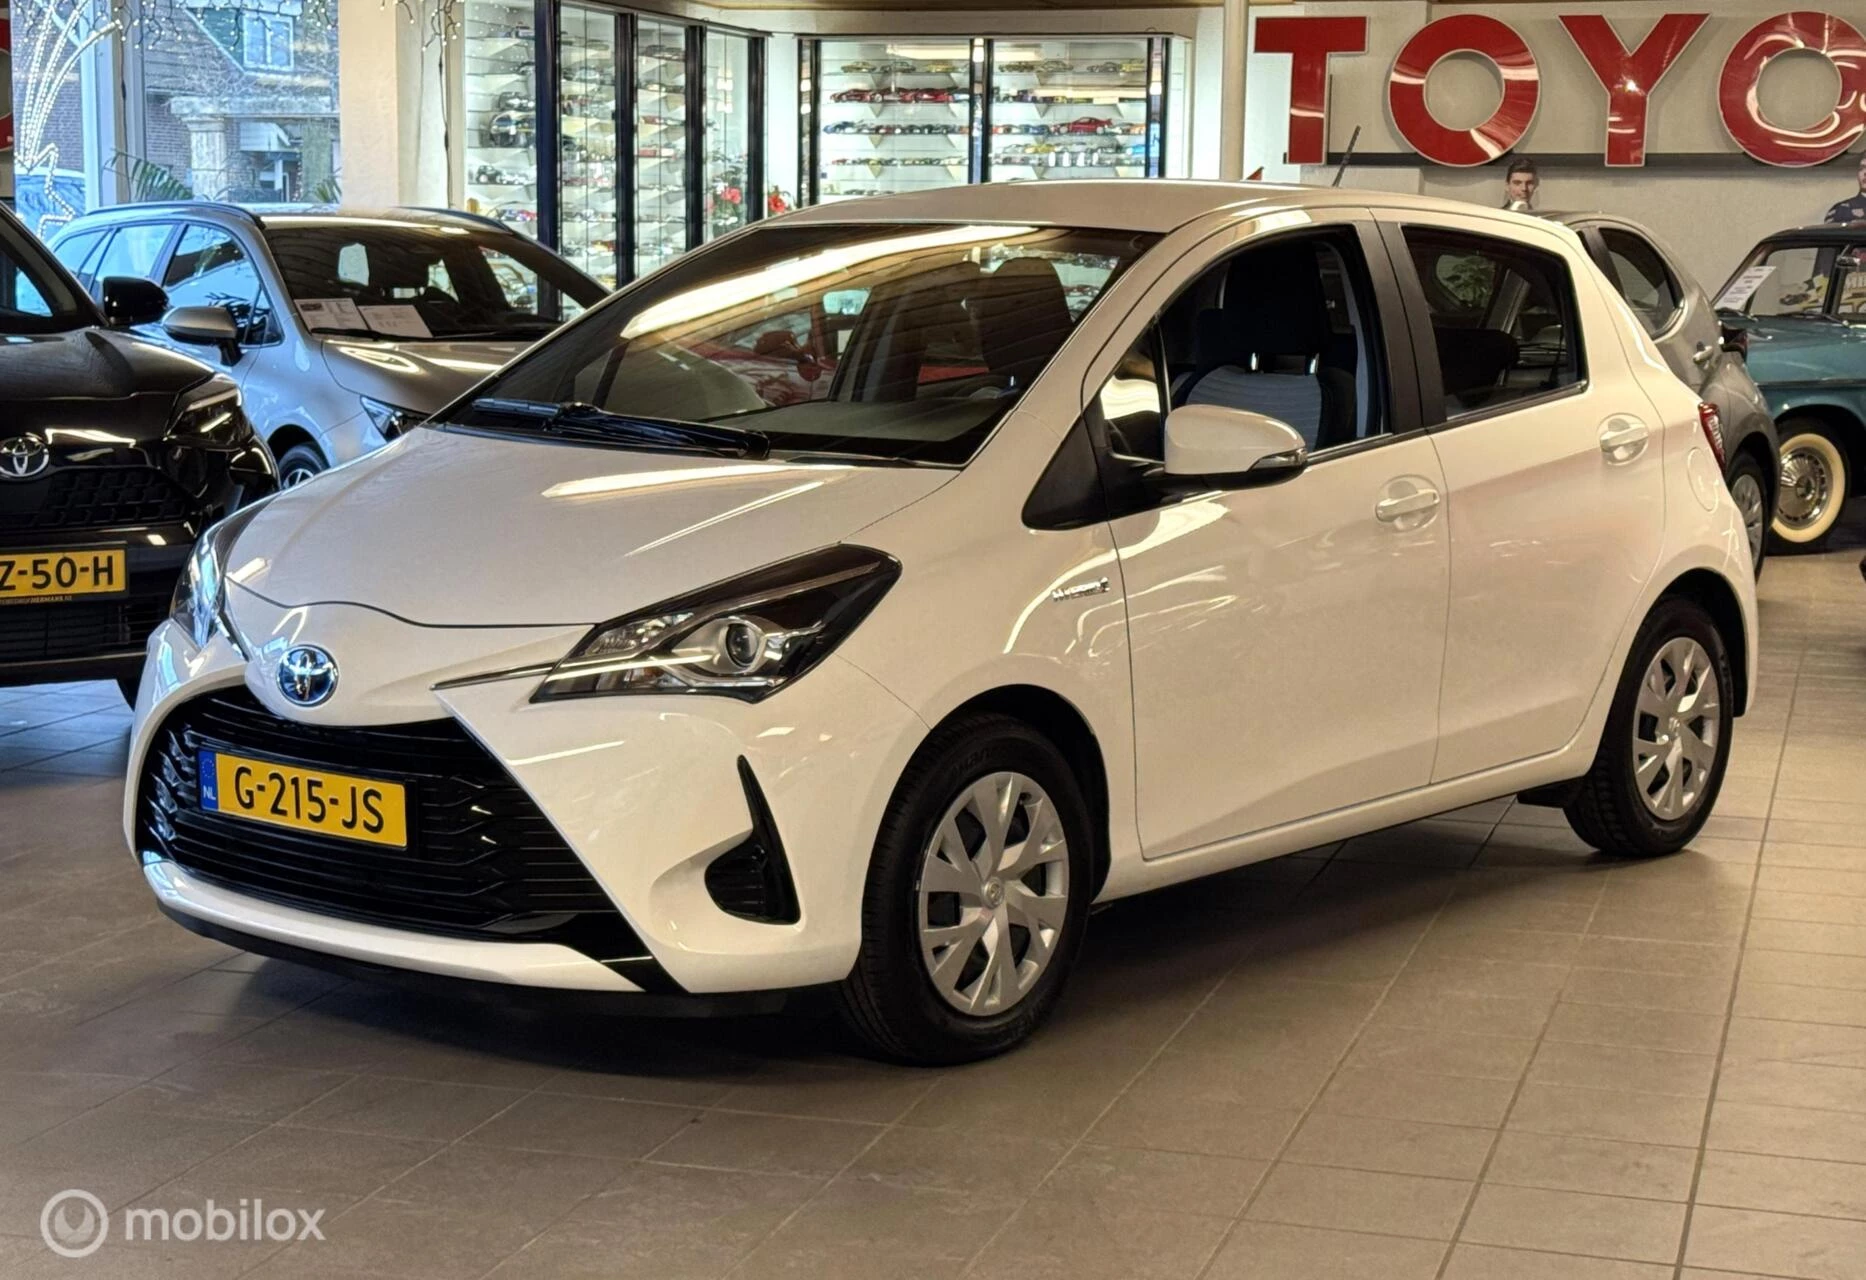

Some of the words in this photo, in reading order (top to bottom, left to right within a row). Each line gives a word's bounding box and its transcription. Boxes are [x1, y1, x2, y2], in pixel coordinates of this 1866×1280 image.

[1254, 11, 1866, 167] TOYO
[203, 785, 217, 801] NL
[234, 765, 384, 834] G-215-JS
